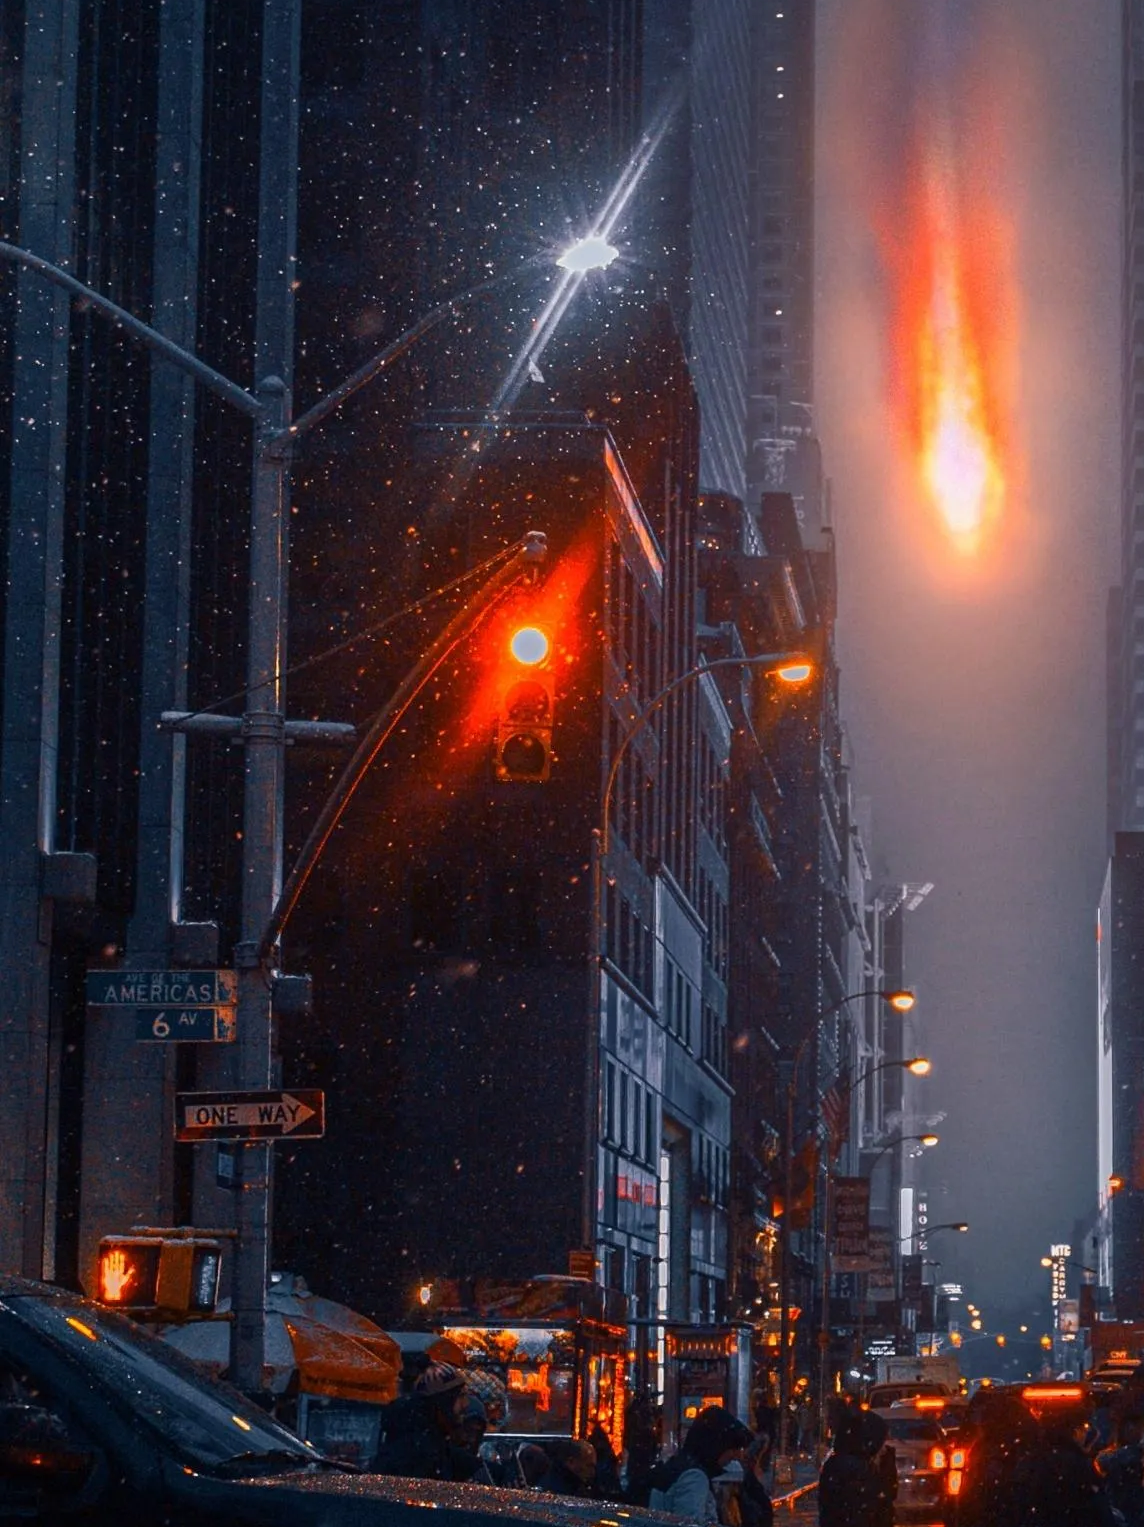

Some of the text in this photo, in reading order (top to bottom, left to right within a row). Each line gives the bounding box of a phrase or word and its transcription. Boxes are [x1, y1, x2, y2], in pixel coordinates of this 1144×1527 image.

[125, 973, 191, 984] AVE OF THE
[104, 983, 212, 1002] AMERICAS
[152, 1011, 198, 1037] 6 AV
[196, 1104, 301, 1125] ONE WAY
